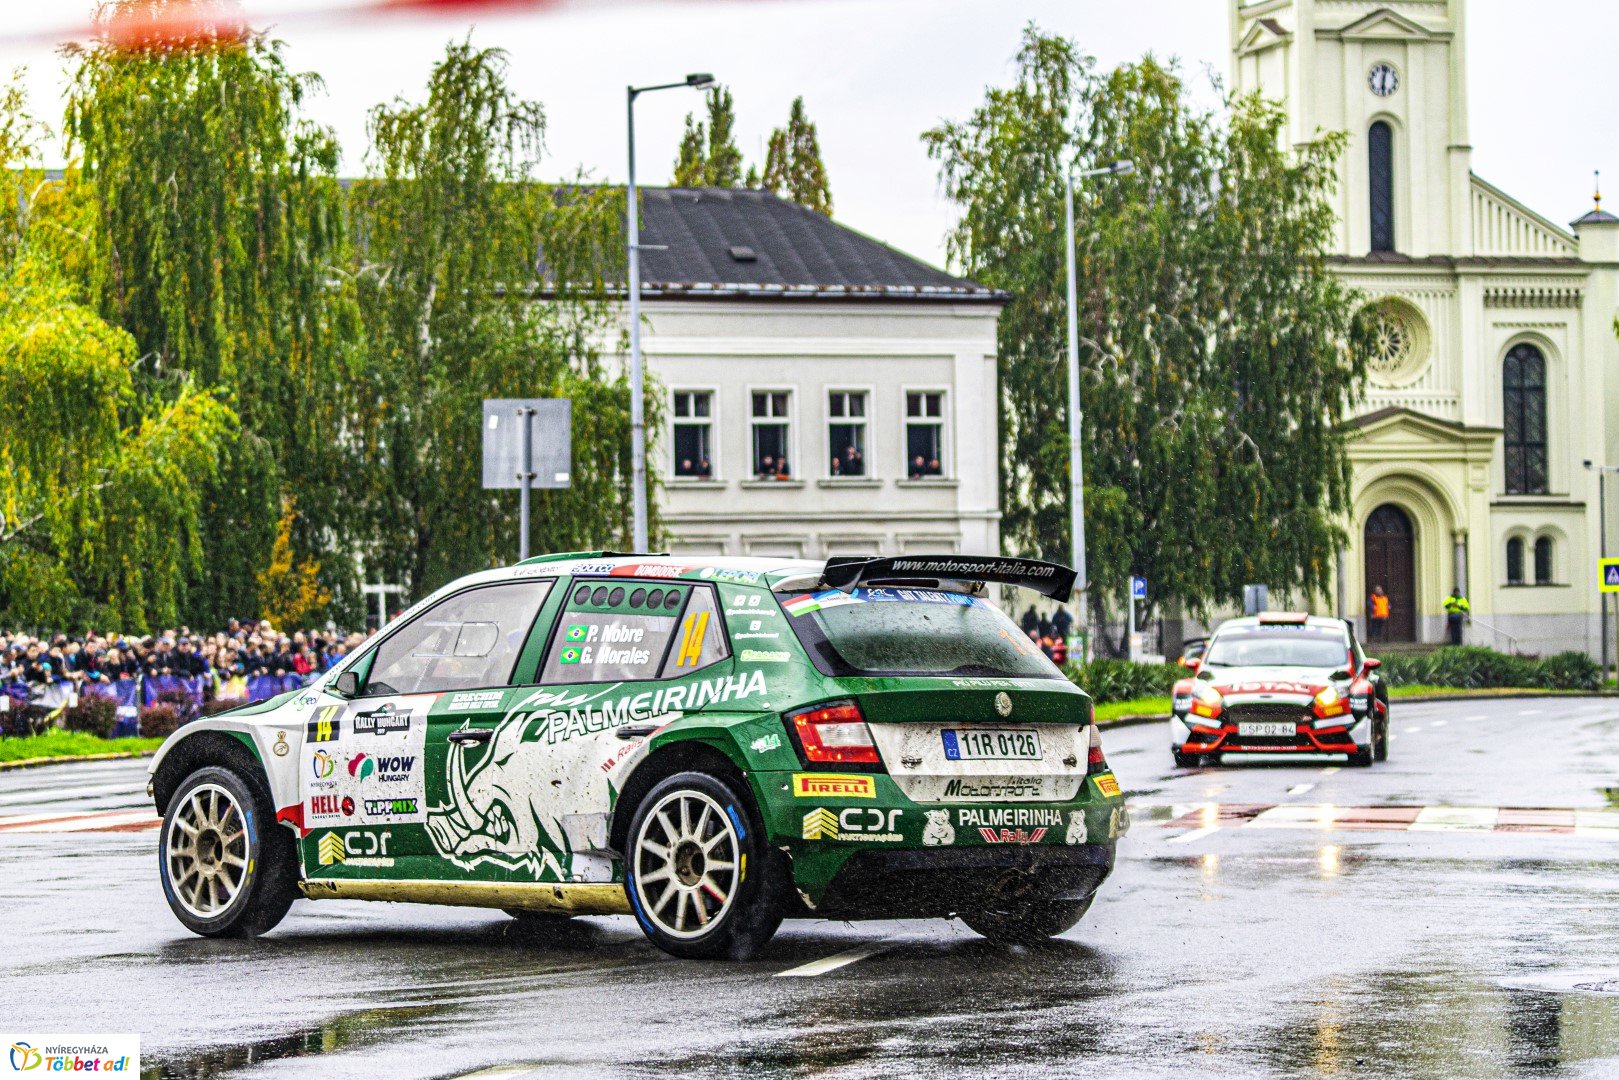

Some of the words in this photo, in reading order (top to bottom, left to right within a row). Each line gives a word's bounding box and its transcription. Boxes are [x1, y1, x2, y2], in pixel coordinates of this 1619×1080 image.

[892, 560, 1055, 577] www.motorsport-italia.com
[1135, 581, 1144, 592] P
[586, 625, 598, 643] P.
[601, 624, 644, 643] Nobre
[676, 611, 710, 667] 14
[581, 649, 593, 664] G.
[597, 647, 650, 665] Morales
[1231, 682, 1311, 693] TOTAL
[548, 670, 767, 744] PALMEIRINHA
[316, 705, 339, 742] 14
[355, 716, 376, 729] RALLY
[377, 713, 409, 728] HUNGARY
[1248, 725, 1263, 735] SP
[948, 749, 958, 757] CZ
[961, 734, 992, 756] 11R
[999, 735, 1035, 756] 0126
[377, 756, 415, 772] WOW
[378, 773, 410, 782] HUNGARY
[801, 777, 868, 794] PIRELLI
[944, 780, 1040, 797] Motorsport
[311, 795, 340, 814] HELL
[959, 809, 1063, 826] PALMEIRINHA
[1000, 829, 1028, 844] Rally
